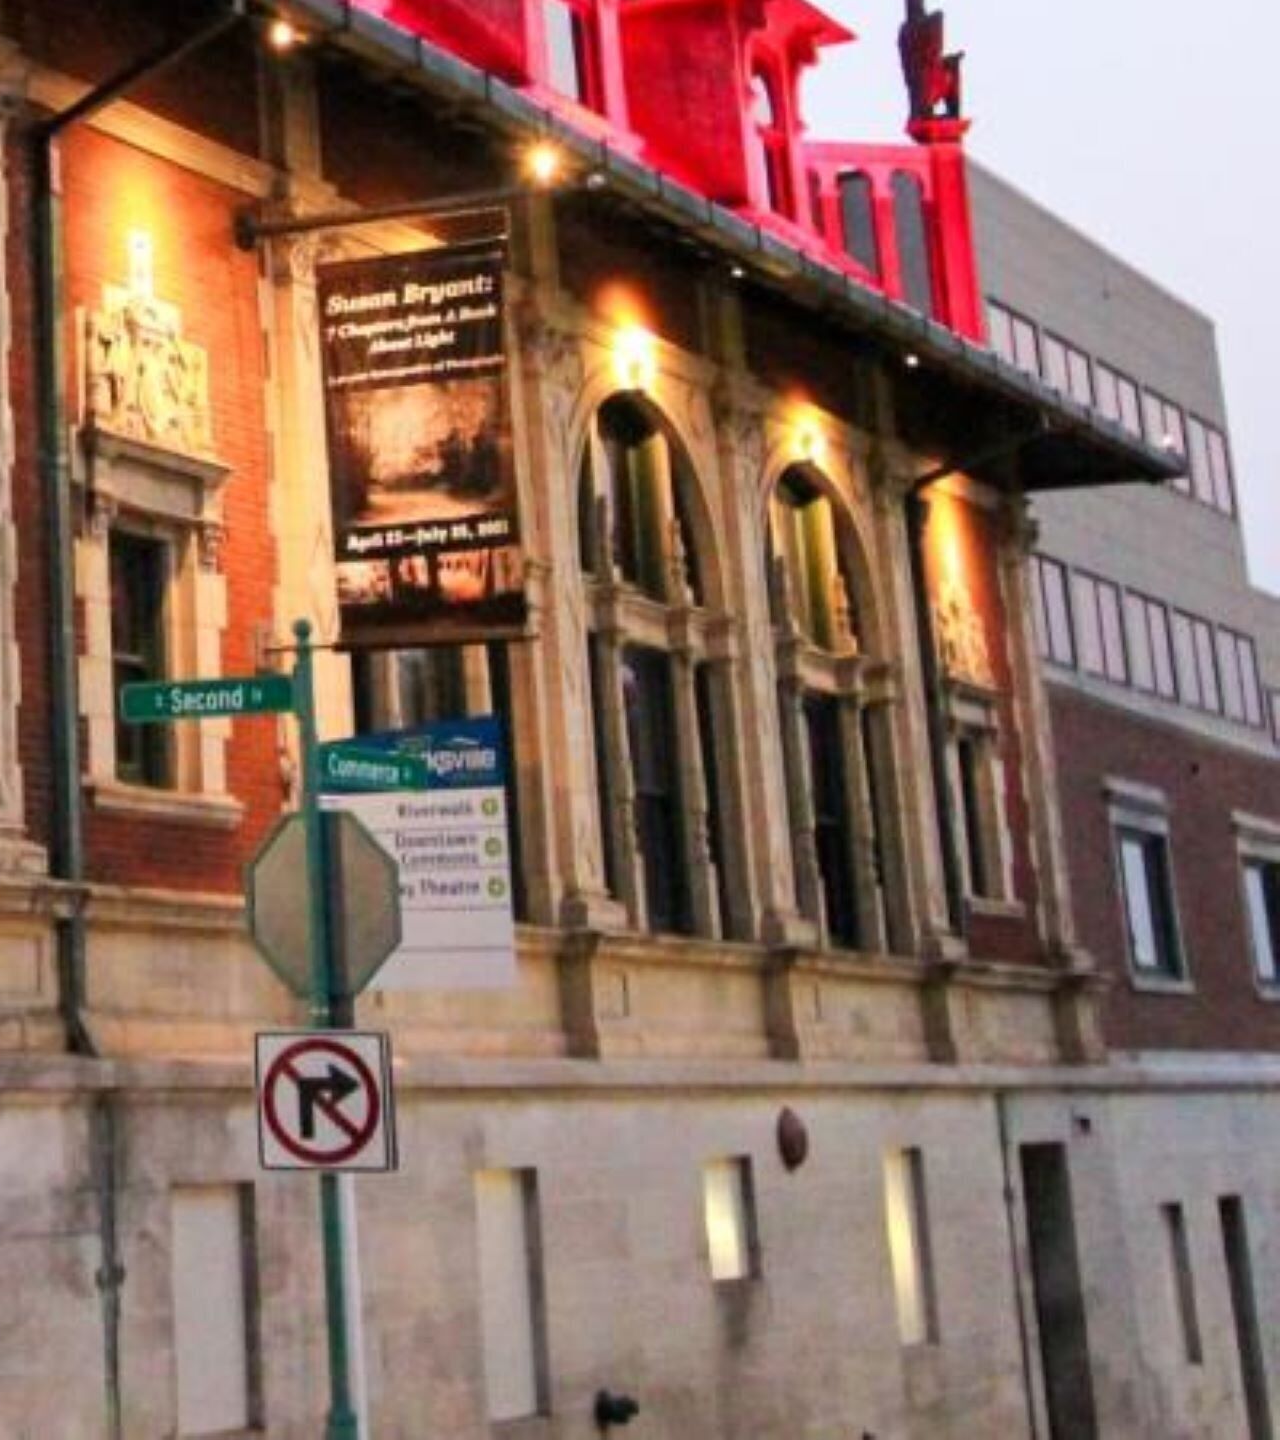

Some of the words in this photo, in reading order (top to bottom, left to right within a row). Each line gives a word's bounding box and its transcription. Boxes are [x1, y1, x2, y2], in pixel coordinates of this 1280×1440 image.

[325, 290, 397, 316] Susan
[402, 273, 493, 306] Bryant:
[414, 329, 456, 350] Light
[347, 533, 384, 554] April
[170, 683, 244, 714] Second
[328, 751, 400, 783] Commerce
[397, 801, 473, 819] Riverwalk
[395, 831, 477, 849] Downtown
[420, 879, 480, 897] Theatre
